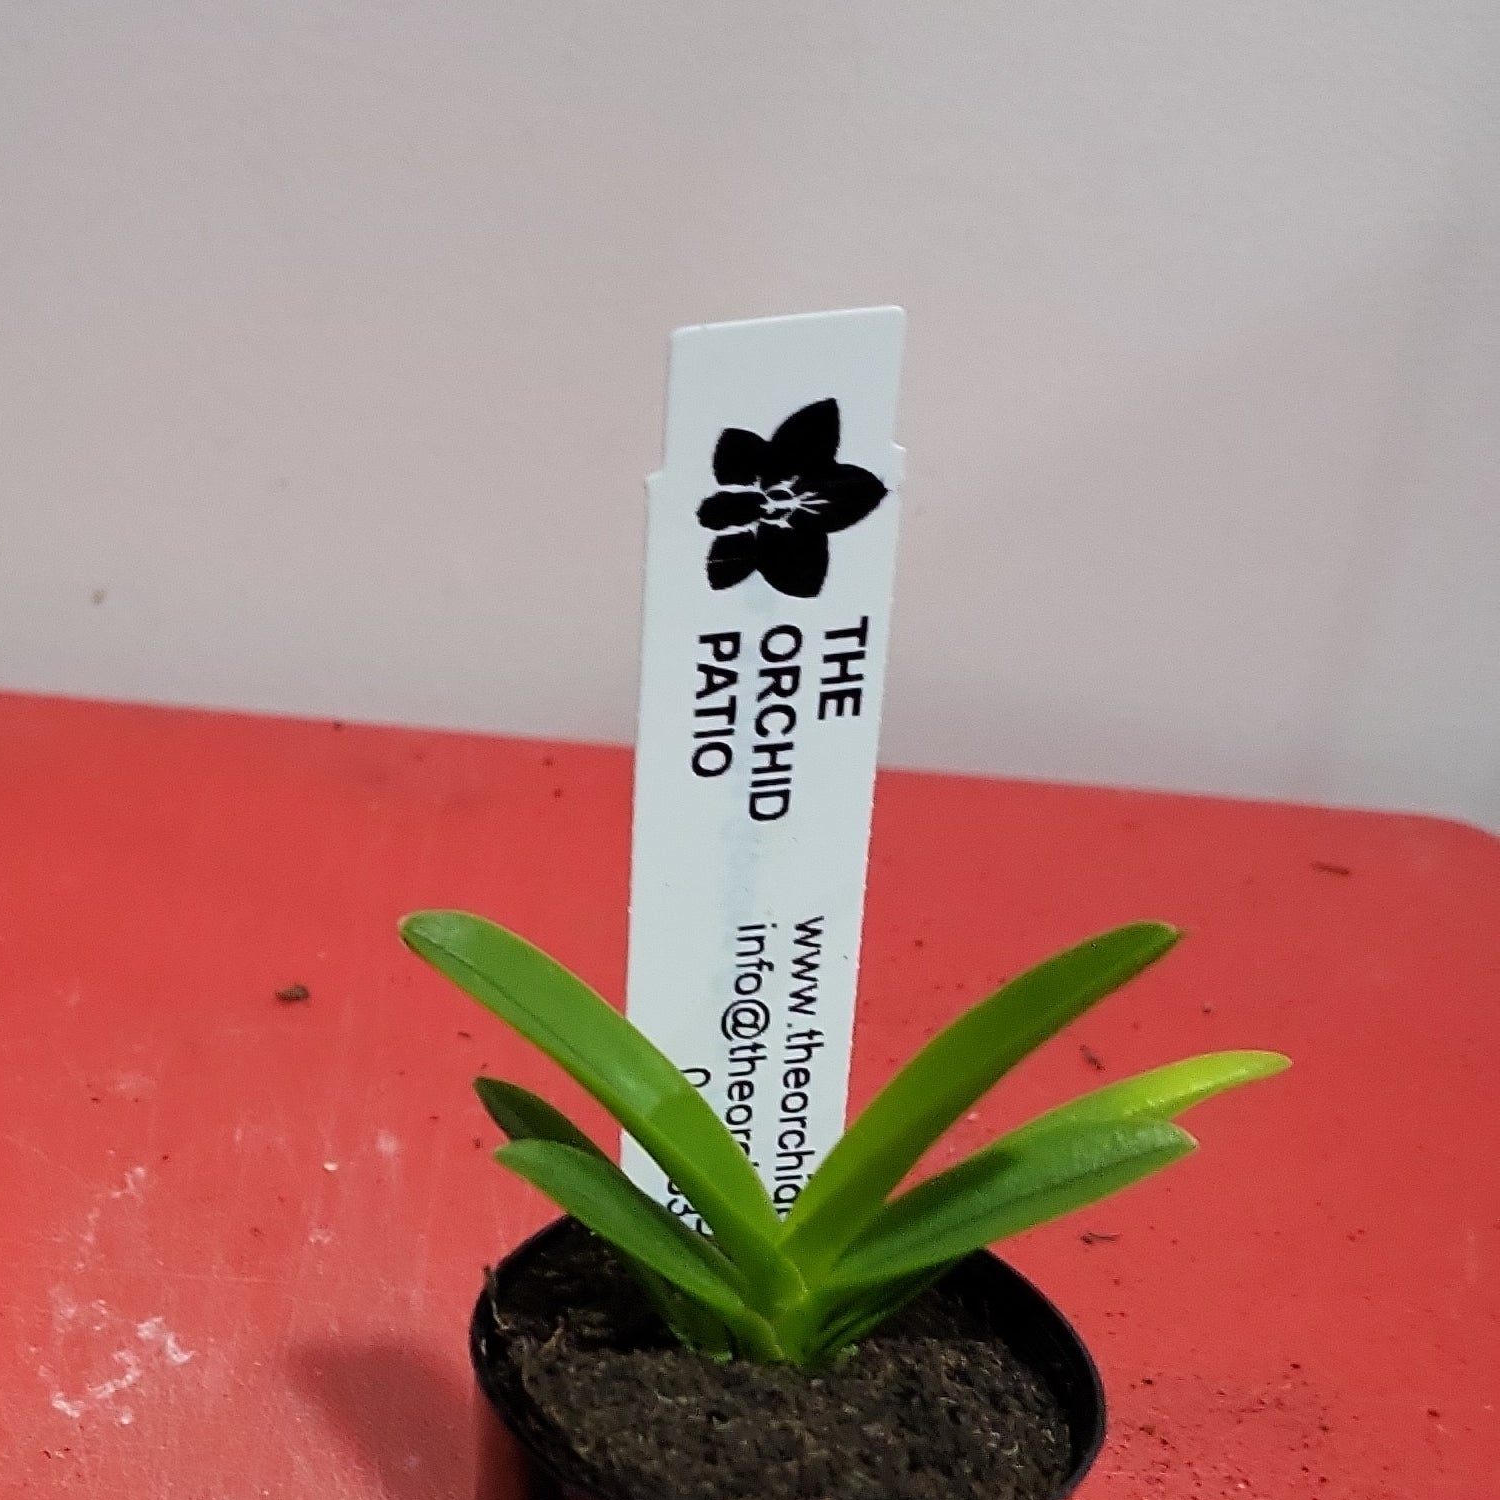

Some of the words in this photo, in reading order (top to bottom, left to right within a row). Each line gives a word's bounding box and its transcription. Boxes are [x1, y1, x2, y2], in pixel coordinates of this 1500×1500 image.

[691, 631, 741, 778] PATIO
[748, 624, 803, 822] ORCHID
[817, 615, 869, 720] THE
